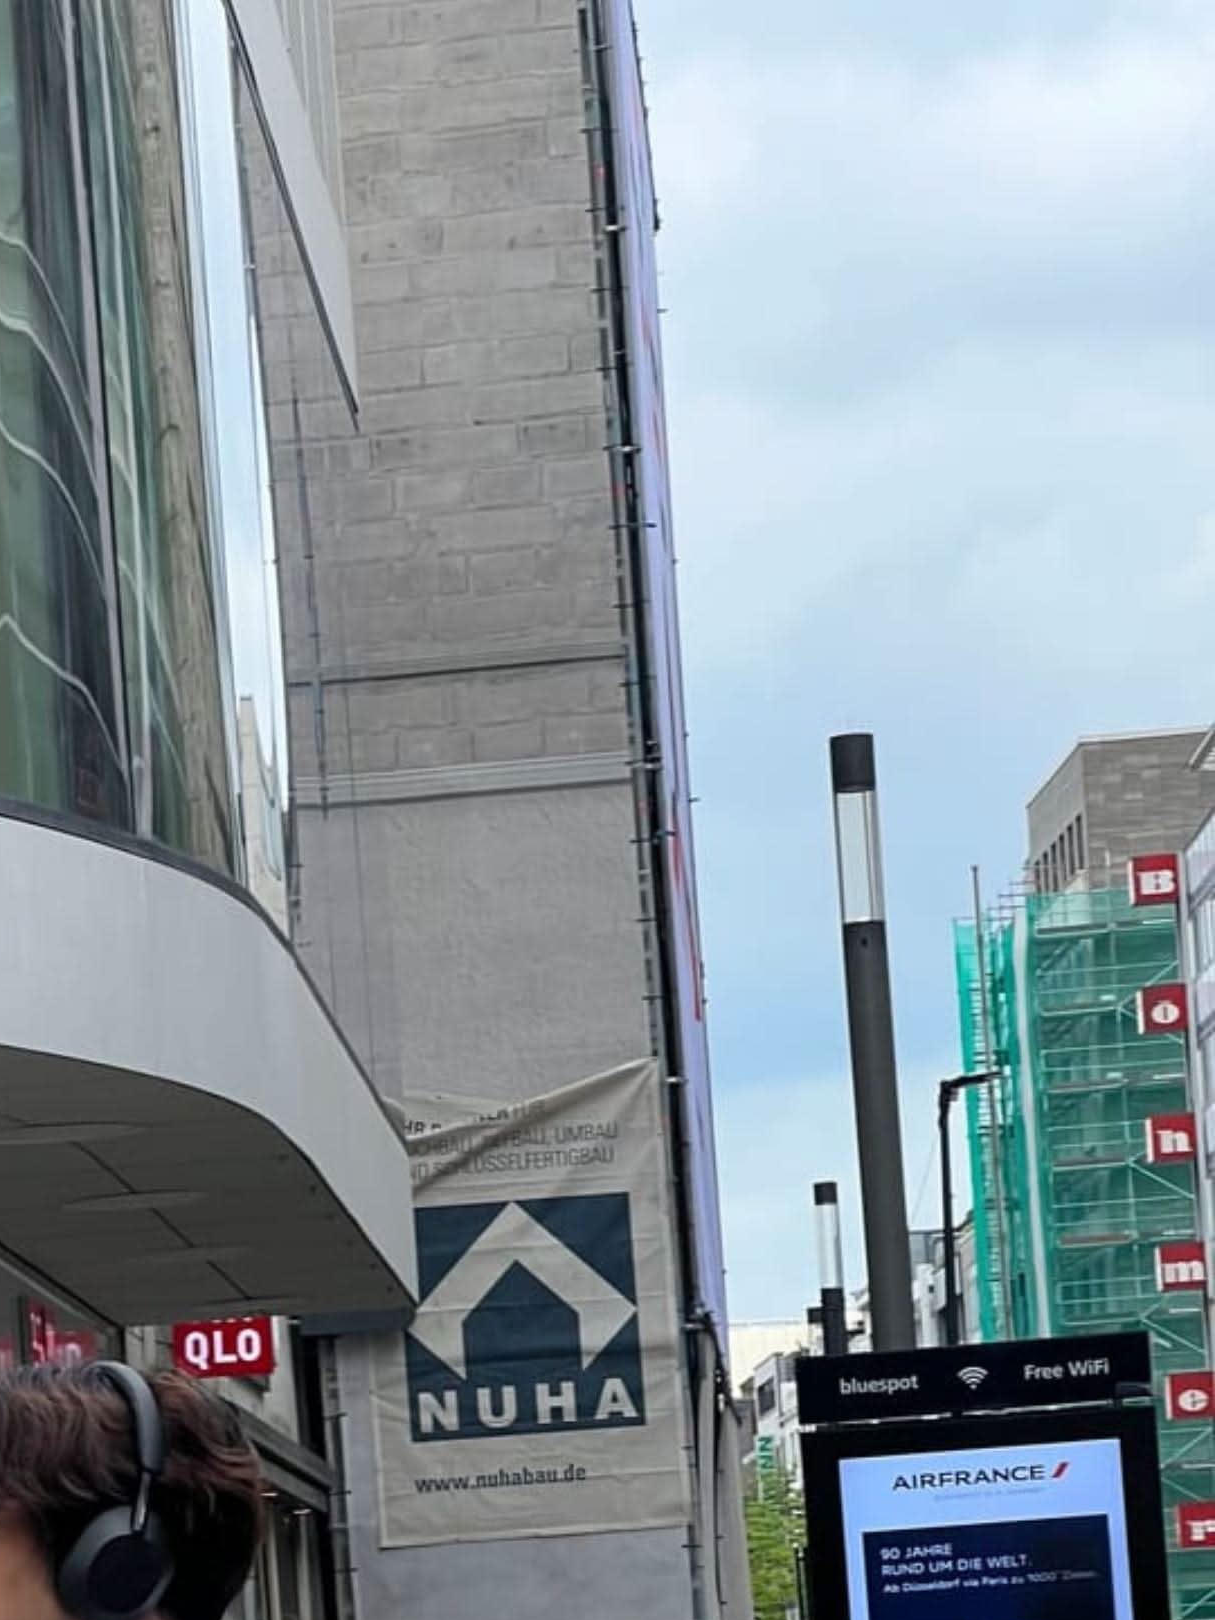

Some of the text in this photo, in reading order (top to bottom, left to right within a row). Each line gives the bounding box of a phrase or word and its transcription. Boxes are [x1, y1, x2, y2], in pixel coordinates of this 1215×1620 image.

[554, 1120, 619, 1145] UMBAU
[185, 1328, 261, 1370] QLO
[840, 1358, 1110, 1395] bluespot Free WiFi
[417, 1378, 639, 1433] NUHA
[415, 1463, 587, 1495] www.nuhabau.de
[892, 1463, 1046, 1491] AIRFRANCE
[880, 1543, 953, 1560] 90 JAHRE
[881, 1563, 925, 1576] RUND
[928, 1560, 953, 1573] UM
[957, 1557, 983, 1572] DIE
